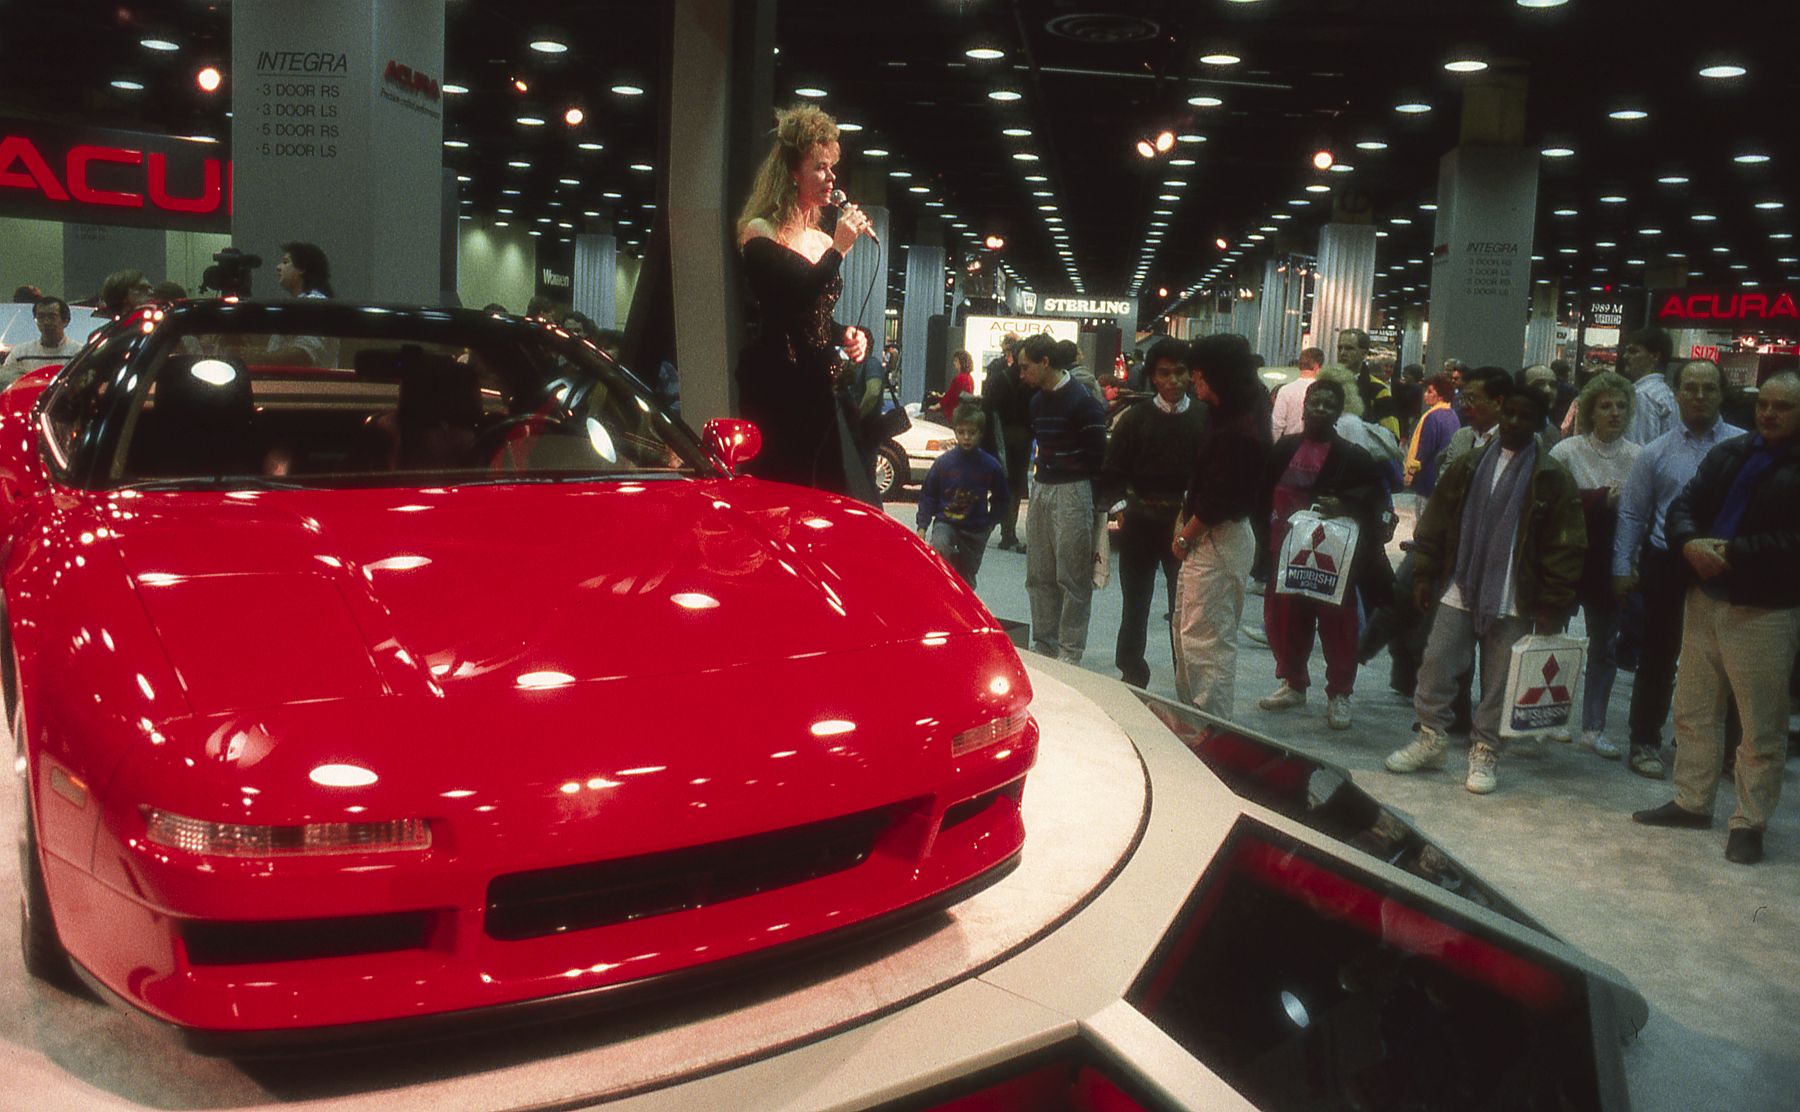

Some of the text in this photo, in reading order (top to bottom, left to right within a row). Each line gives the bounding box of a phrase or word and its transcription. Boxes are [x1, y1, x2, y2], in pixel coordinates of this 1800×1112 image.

[257, 51, 348, 73] INTEGRA
[262, 83, 340, 98] 3 DOOR RS
[262, 102, 338, 118] 3 DOOR LS
[262, 122, 340, 138] 5 DOOR RS
[262, 142, 337, 158] 5 DOOR LS
[0, 135, 232, 214] ACU
[1466, 241, 1519, 256] INTEGRA
[1043, 298, 1131, 315] STERLING
[1591, 303, 1611, 313] 1989
[1658, 292, 1800, 320] ACURA
[990, 320, 1055, 334] ACURA
